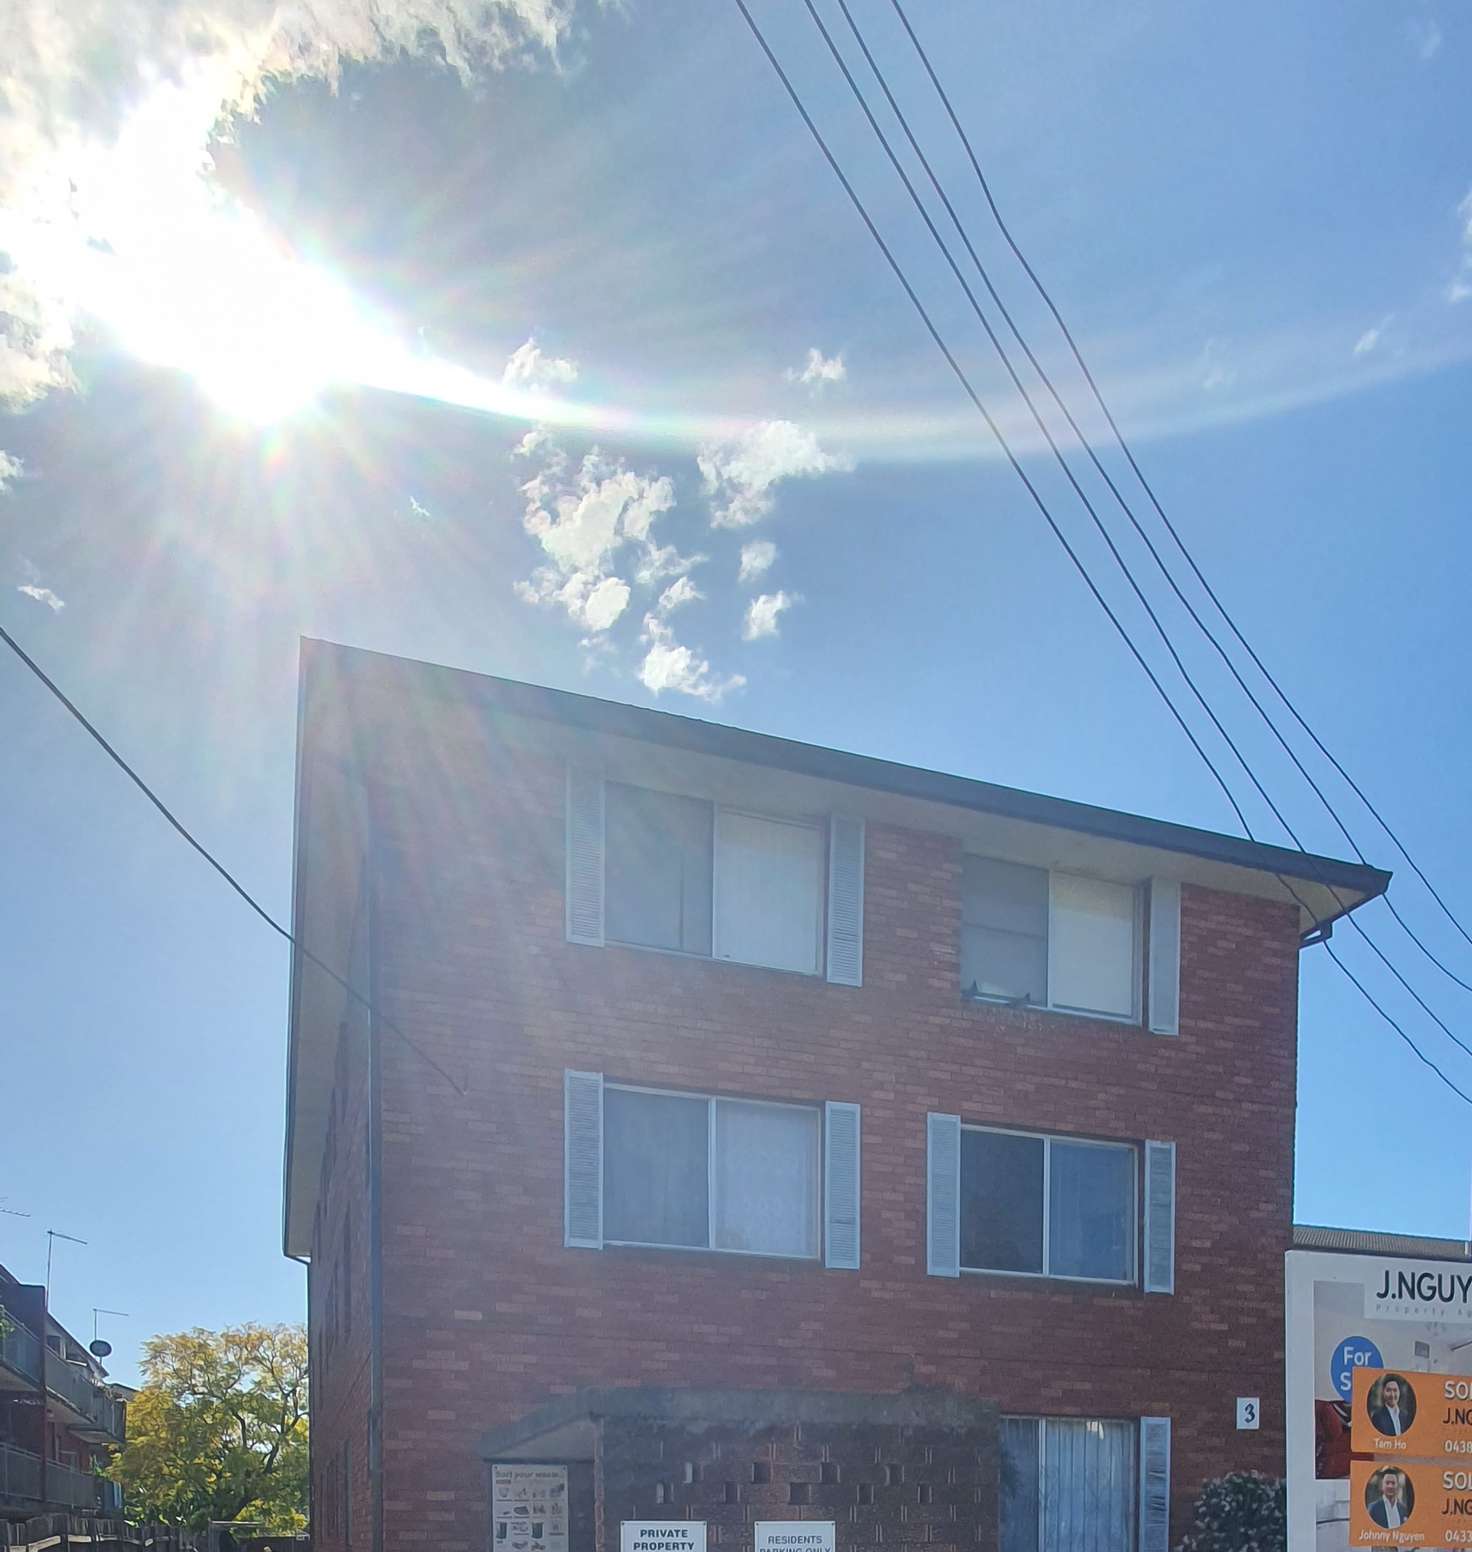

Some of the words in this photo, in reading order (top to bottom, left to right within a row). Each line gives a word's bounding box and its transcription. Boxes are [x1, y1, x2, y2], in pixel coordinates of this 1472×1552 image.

[1376, 1270, 1472, 1304] J.NGUY
[1343, 1346, 1372, 1366] For
[1245, 1403, 1256, 1423] 3
[640, 1529, 689, 1538] PRIVATE
[767, 1535, 824, 1545] RESIDENTS
[1392, 1531, 1425, 1544] Nguyen
[633, 1542, 695, 1551] PROPERTY
